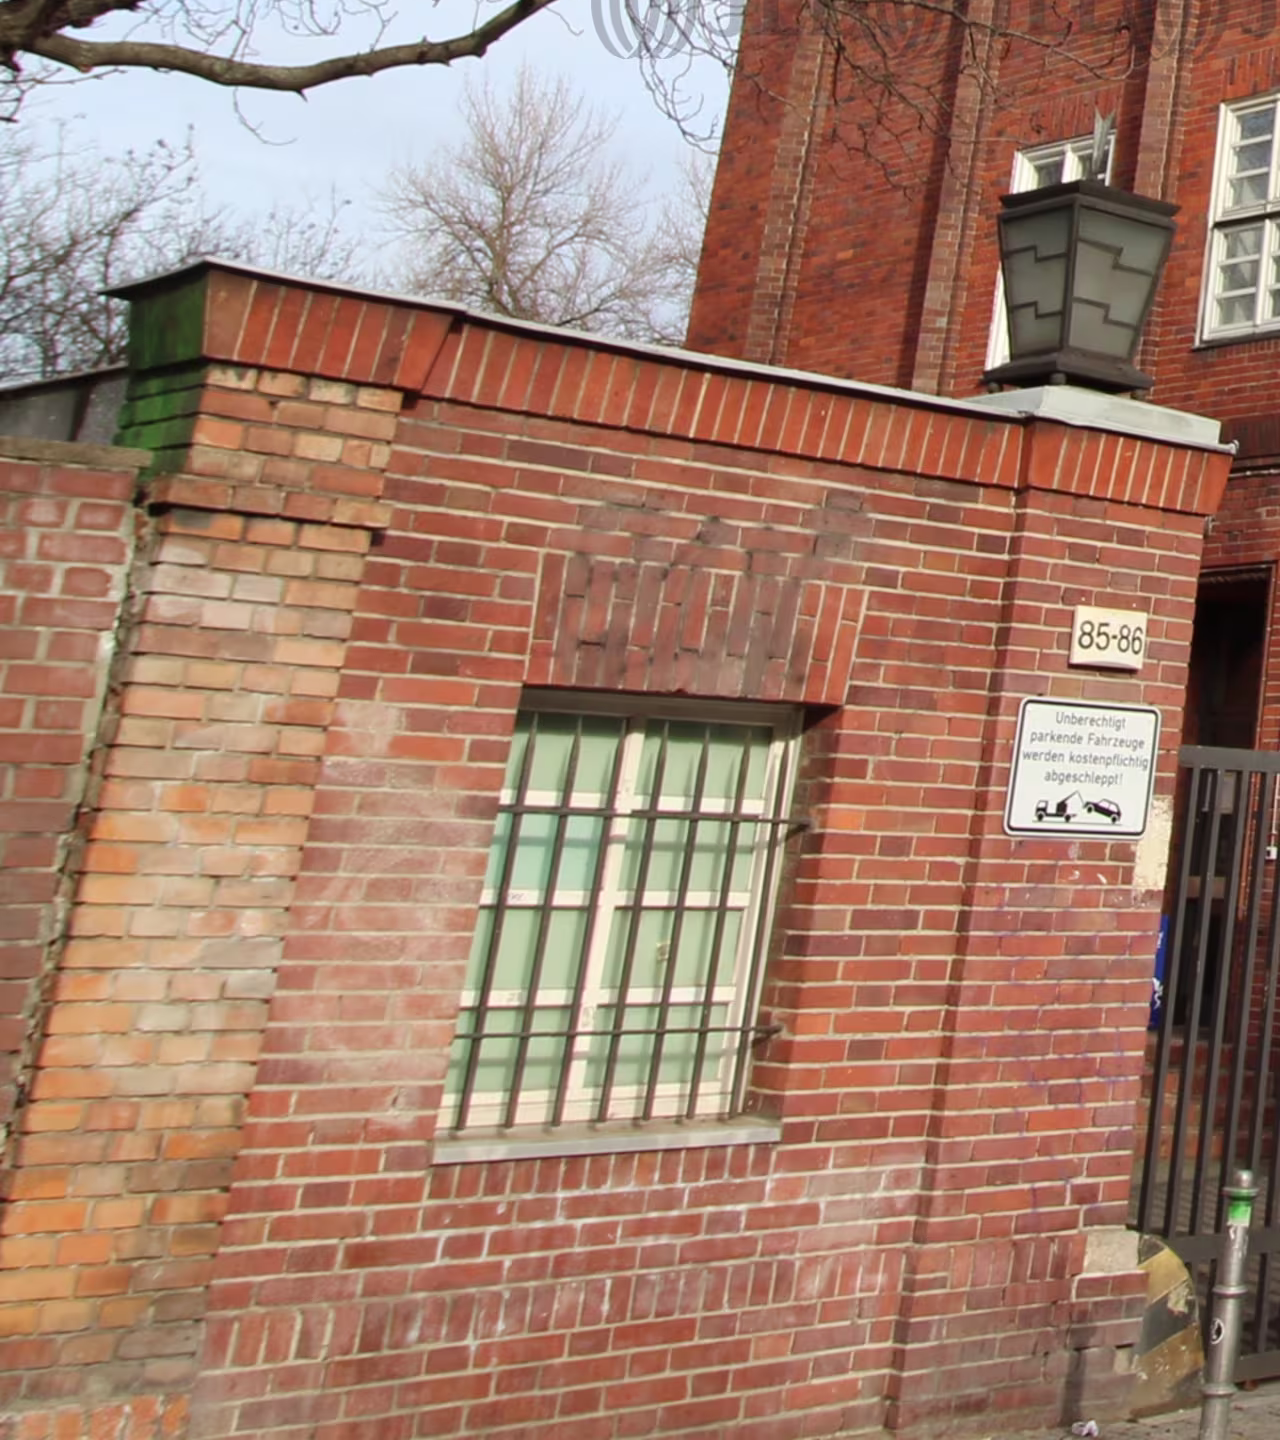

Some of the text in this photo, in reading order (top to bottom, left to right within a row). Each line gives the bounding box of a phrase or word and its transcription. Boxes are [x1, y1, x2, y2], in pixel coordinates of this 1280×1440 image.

[1078, 620, 1144, 655] 85-86
[1055, 712, 1126, 731] Unberechtigt
[1030, 731, 1145, 751] parkende Fahrzeuge
[1022, 750, 1149, 771] werden kostenpflichtig
[1044, 770, 1124, 787] abgeschleppt!
